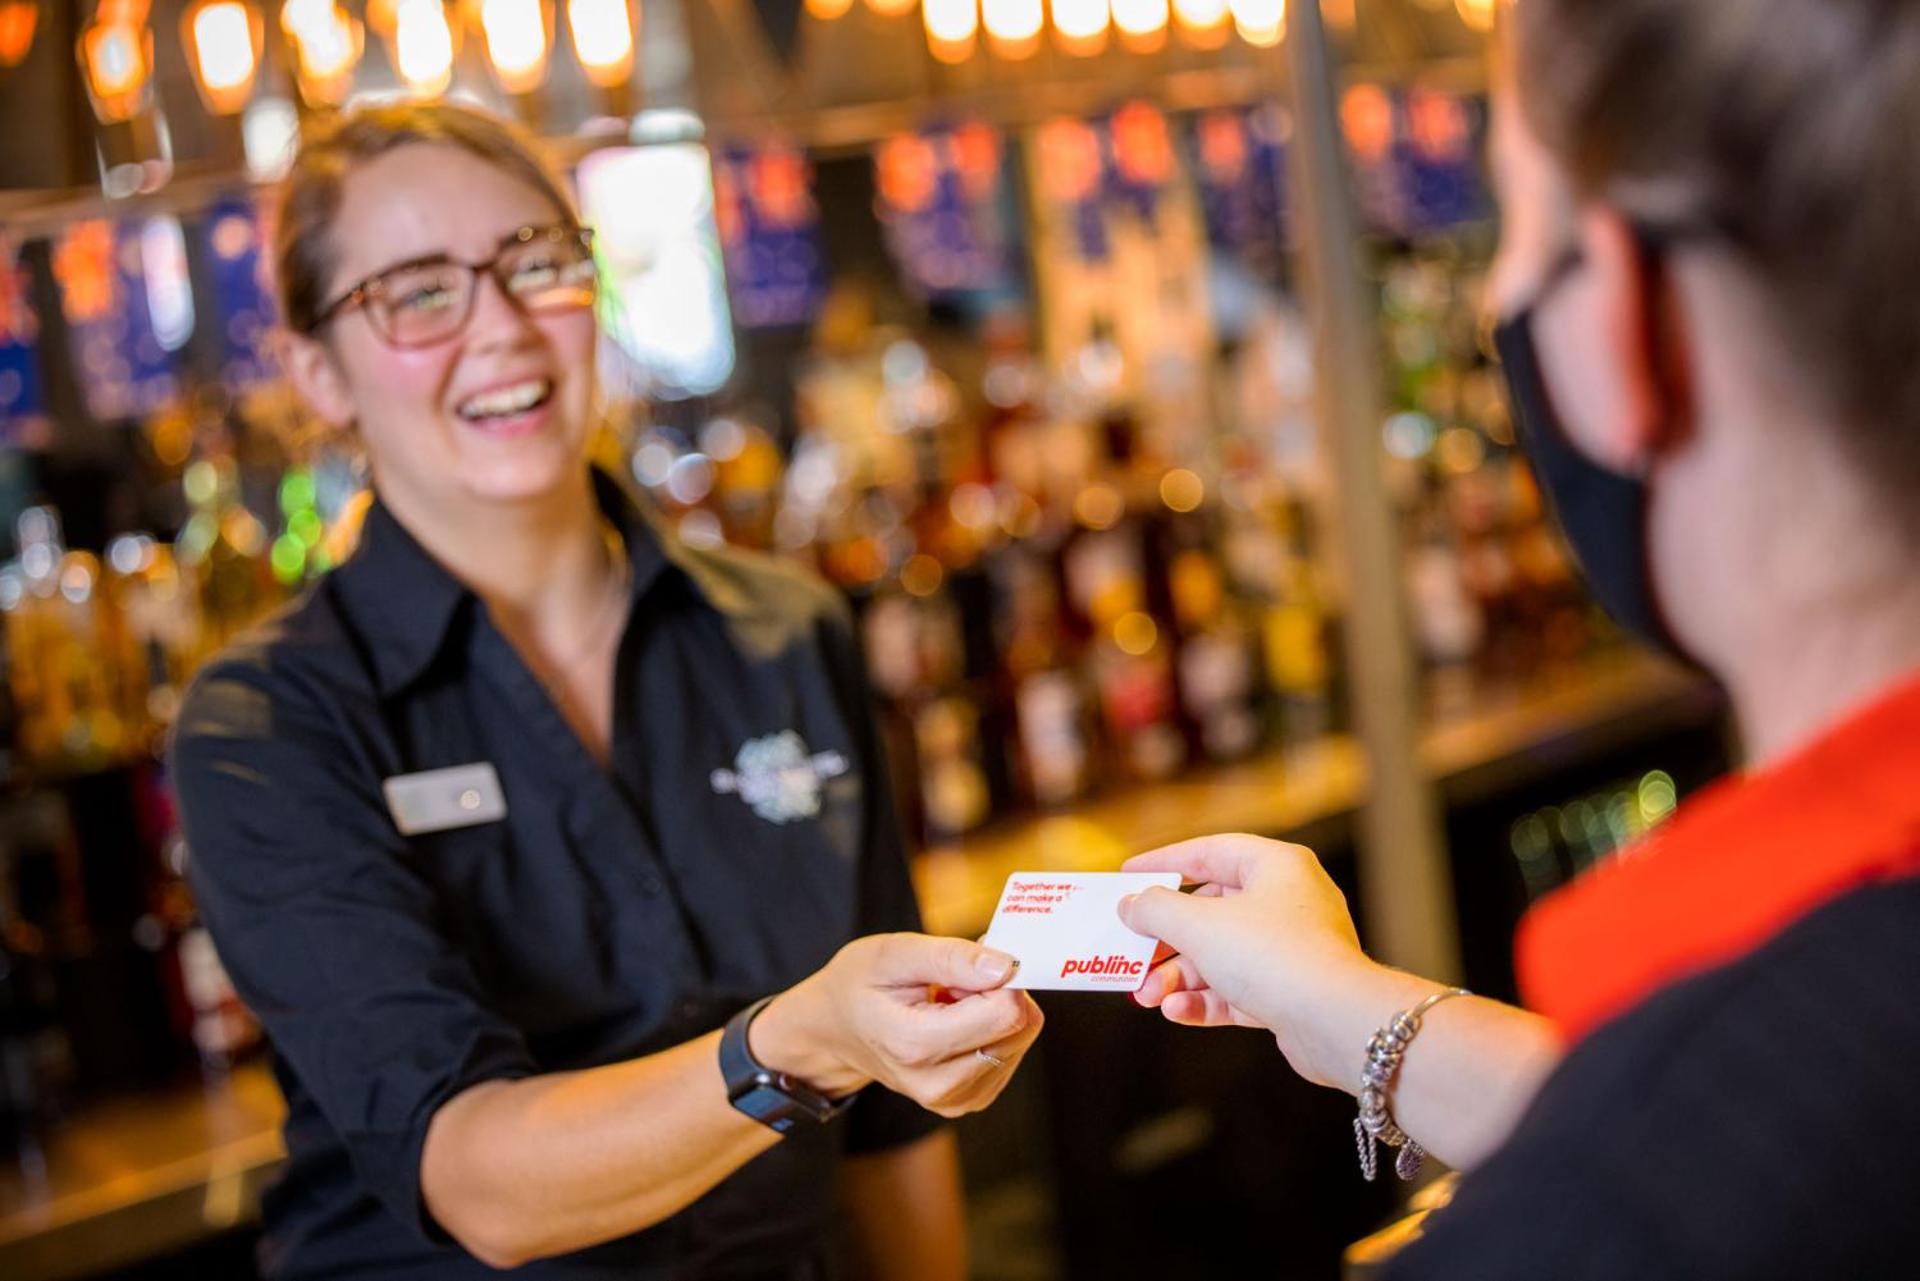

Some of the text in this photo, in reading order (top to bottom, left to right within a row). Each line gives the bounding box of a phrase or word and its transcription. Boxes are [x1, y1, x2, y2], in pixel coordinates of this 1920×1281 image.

[1013, 881, 1055, 892] Together
[1057, 883, 1072, 891] we
[1006, 894, 1025, 902] can
[1027, 893, 1054, 902] make
